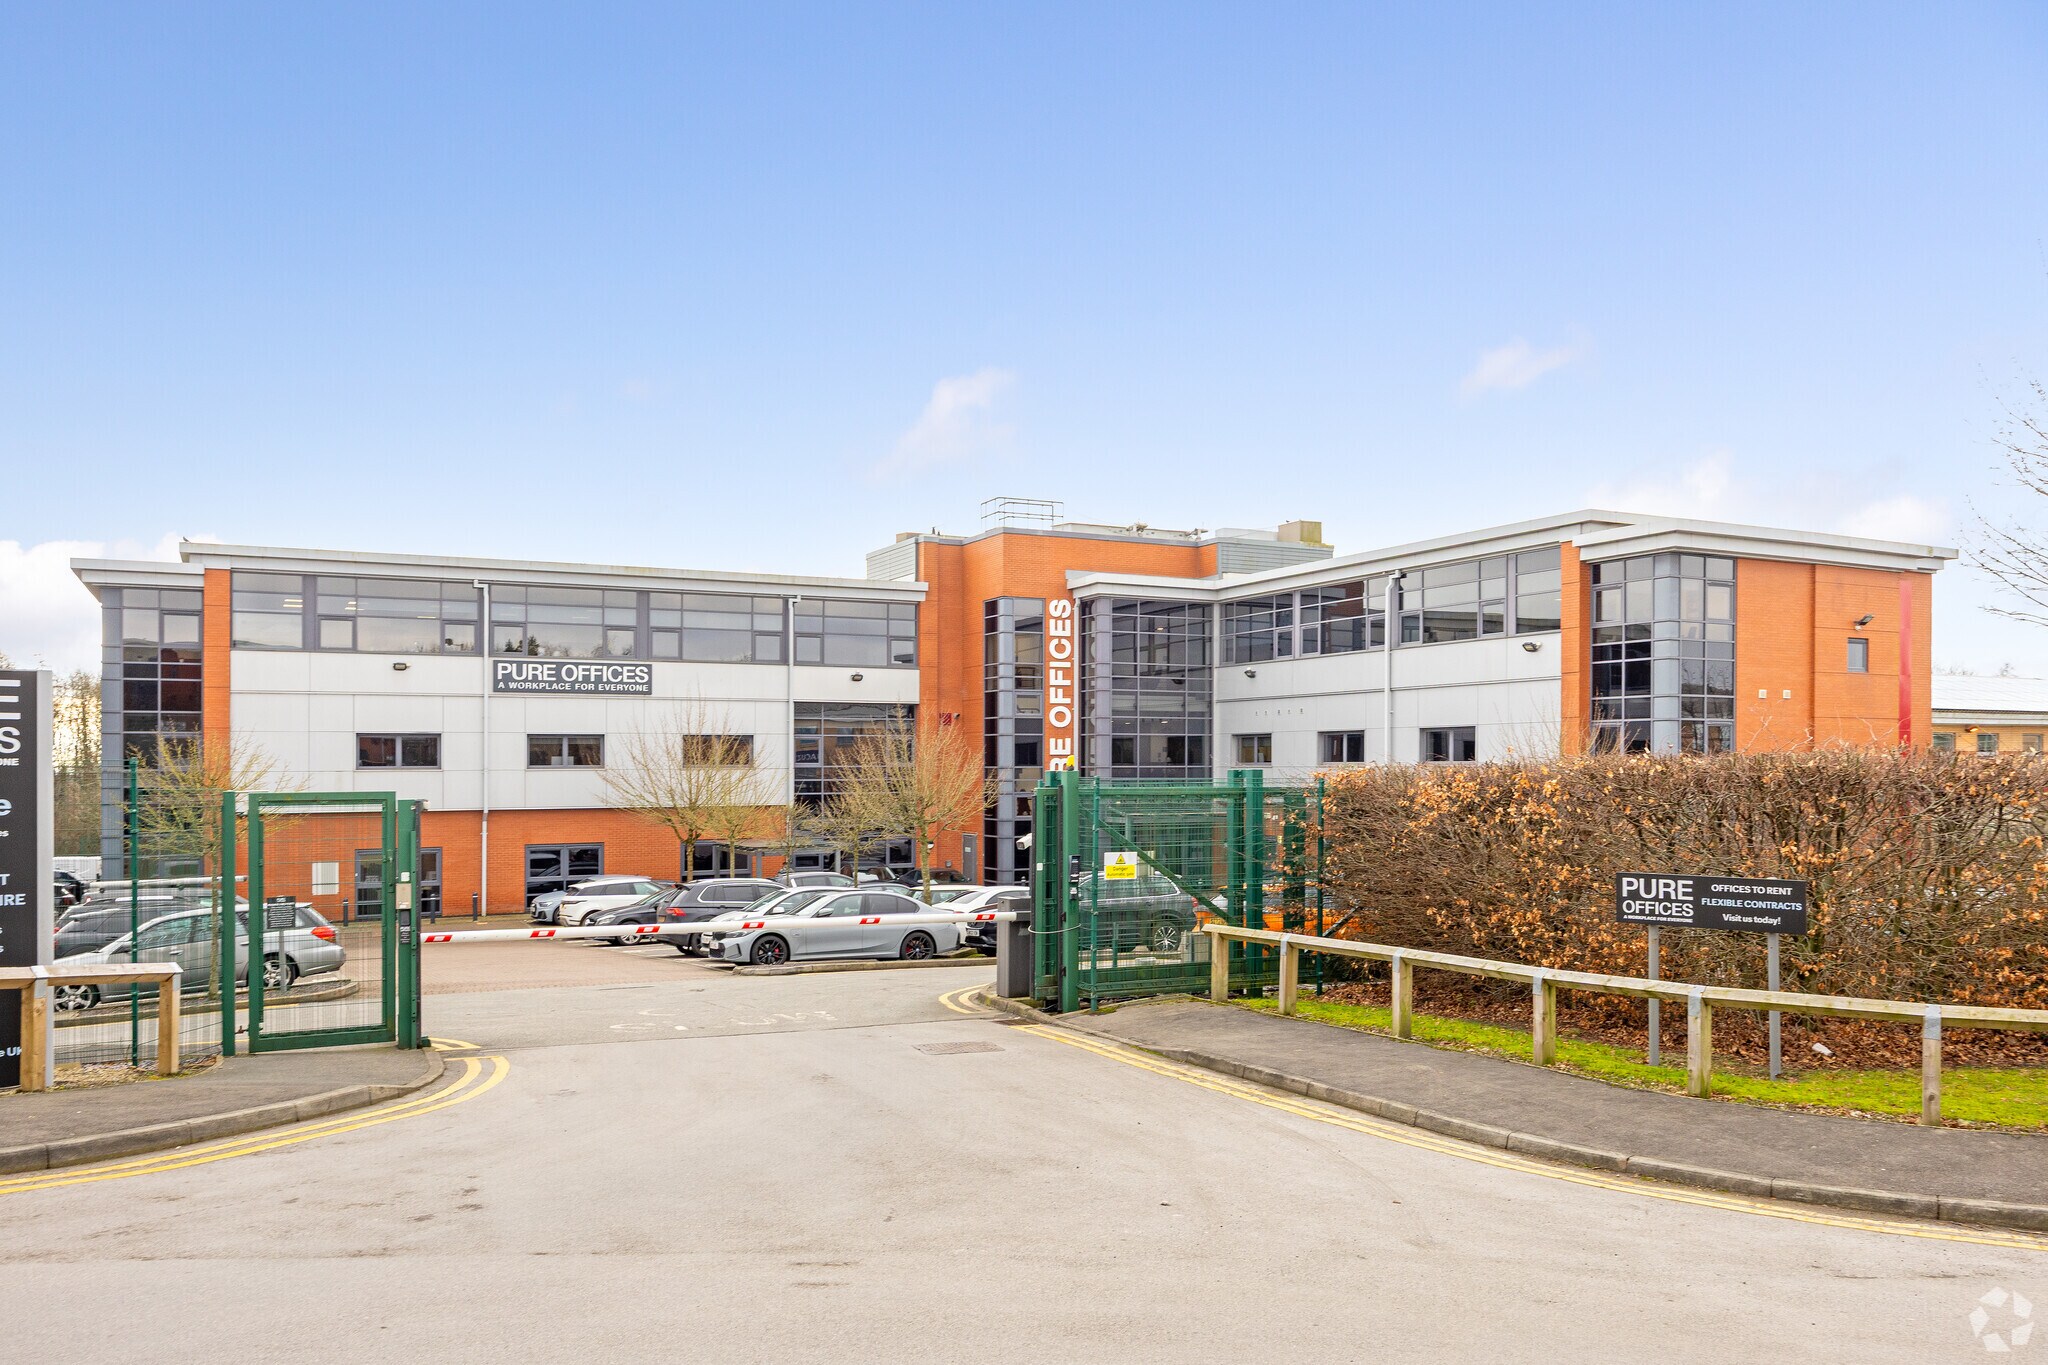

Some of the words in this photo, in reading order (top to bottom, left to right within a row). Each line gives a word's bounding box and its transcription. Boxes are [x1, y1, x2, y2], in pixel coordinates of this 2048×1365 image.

[1049, 599, 1071, 728] OFFICES
[497, 663, 556, 681] PURE
[561, 664, 649, 683] OFFICES
[508, 682, 571, 690] WORKPLACE
[575, 683, 595, 691] FOR
[598, 684, 649, 692] EVERYONE
[1622, 877, 1694, 901] PURE
[1711, 884, 1751, 894] OFFICES
[1751, 885, 1766, 894] TO
[1766, 886, 1793, 895] RENT
[1622, 899, 1694, 917] OFFICES
[1701, 897, 1743, 908] FLEXIBLE
[1743, 900, 1803, 911] CONTRACTS
[1722, 913, 1742, 922] Visit
[1753, 916, 1782, 926] today!
